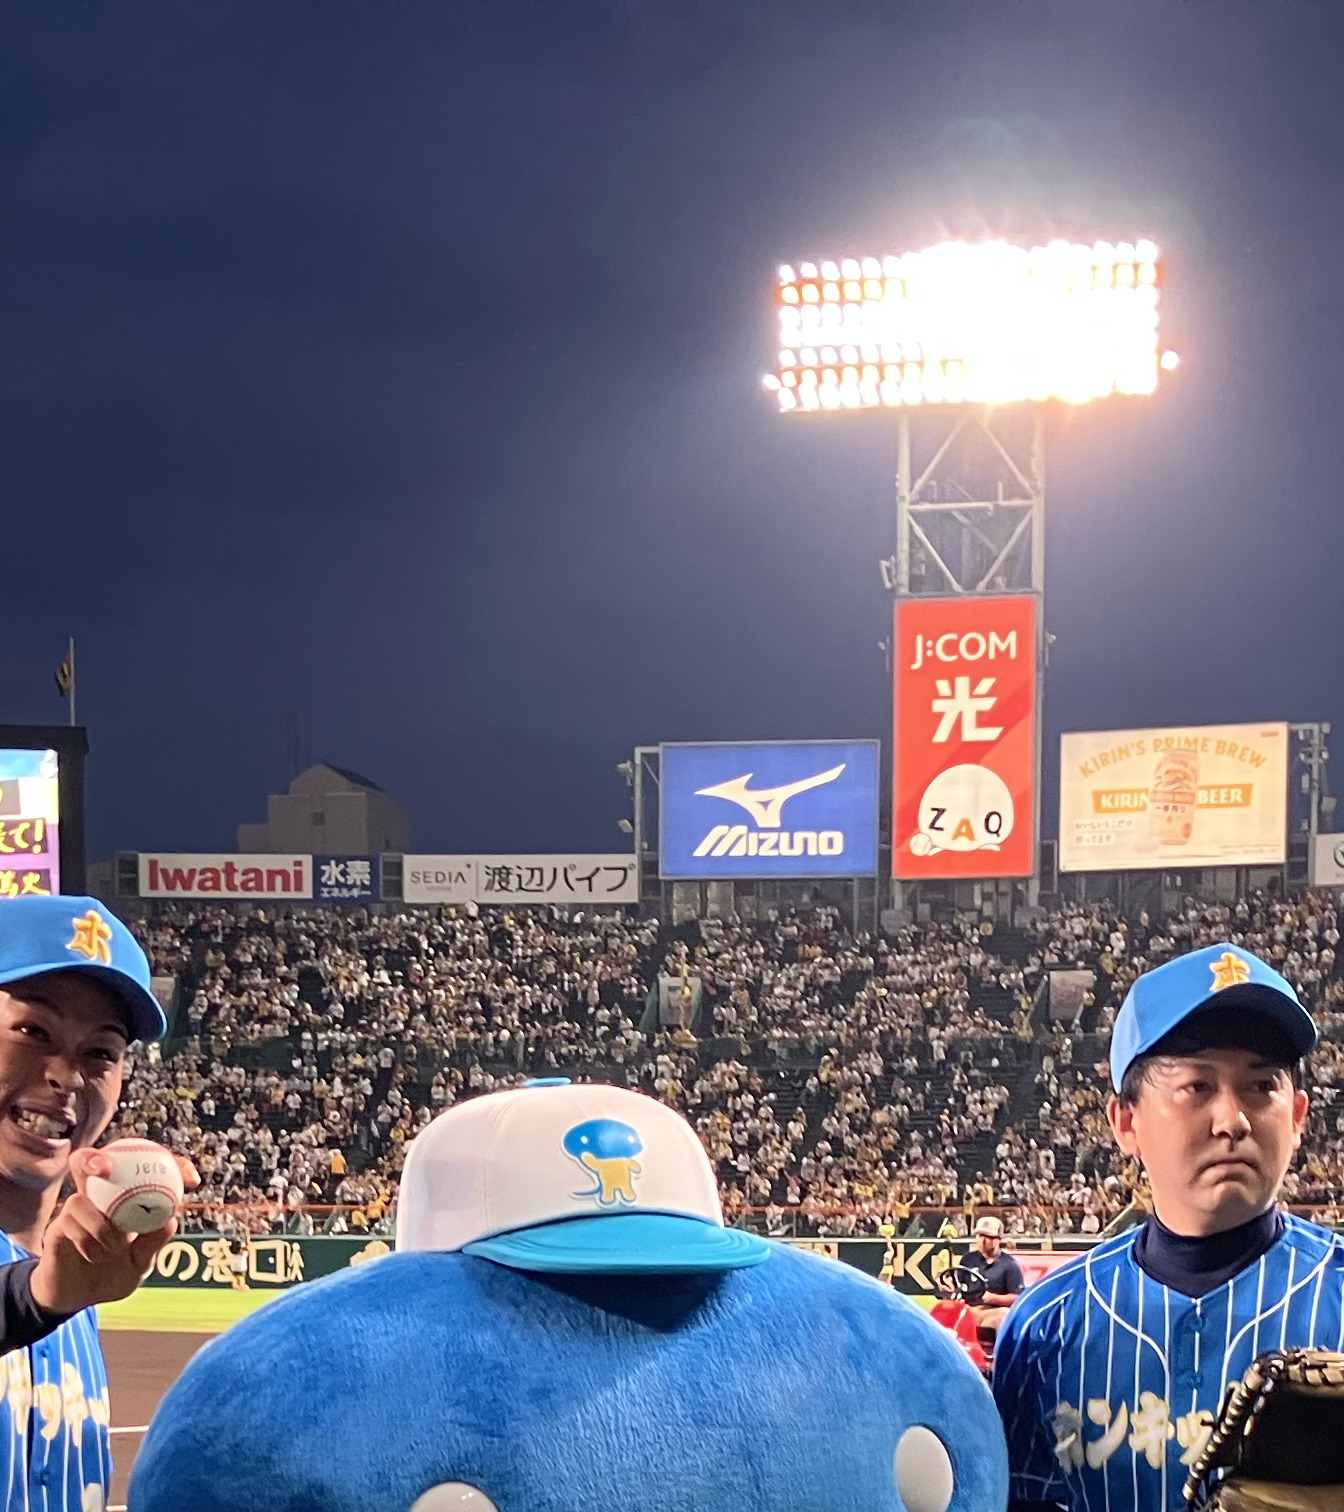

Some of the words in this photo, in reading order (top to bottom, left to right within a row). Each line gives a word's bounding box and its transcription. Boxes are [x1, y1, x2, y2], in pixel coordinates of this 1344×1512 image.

[911, 632, 1016, 670] J:COM
[932, 676, 1002, 743] 光
[1079, 738, 1146, 778] KIRIN'S
[1153, 736, 1211, 753] PRIME
[1215, 739, 1267, 769] BREW
[1198, 789, 1244, 805] BEER
[148, 859, 305, 893] Iwatani
[320, 860, 371, 885] 水素
[411, 871, 466, 884] SEDIA
[484, 862, 636, 894] 渡辺パイプ
[140, 1238, 286, 1283] の窓口
